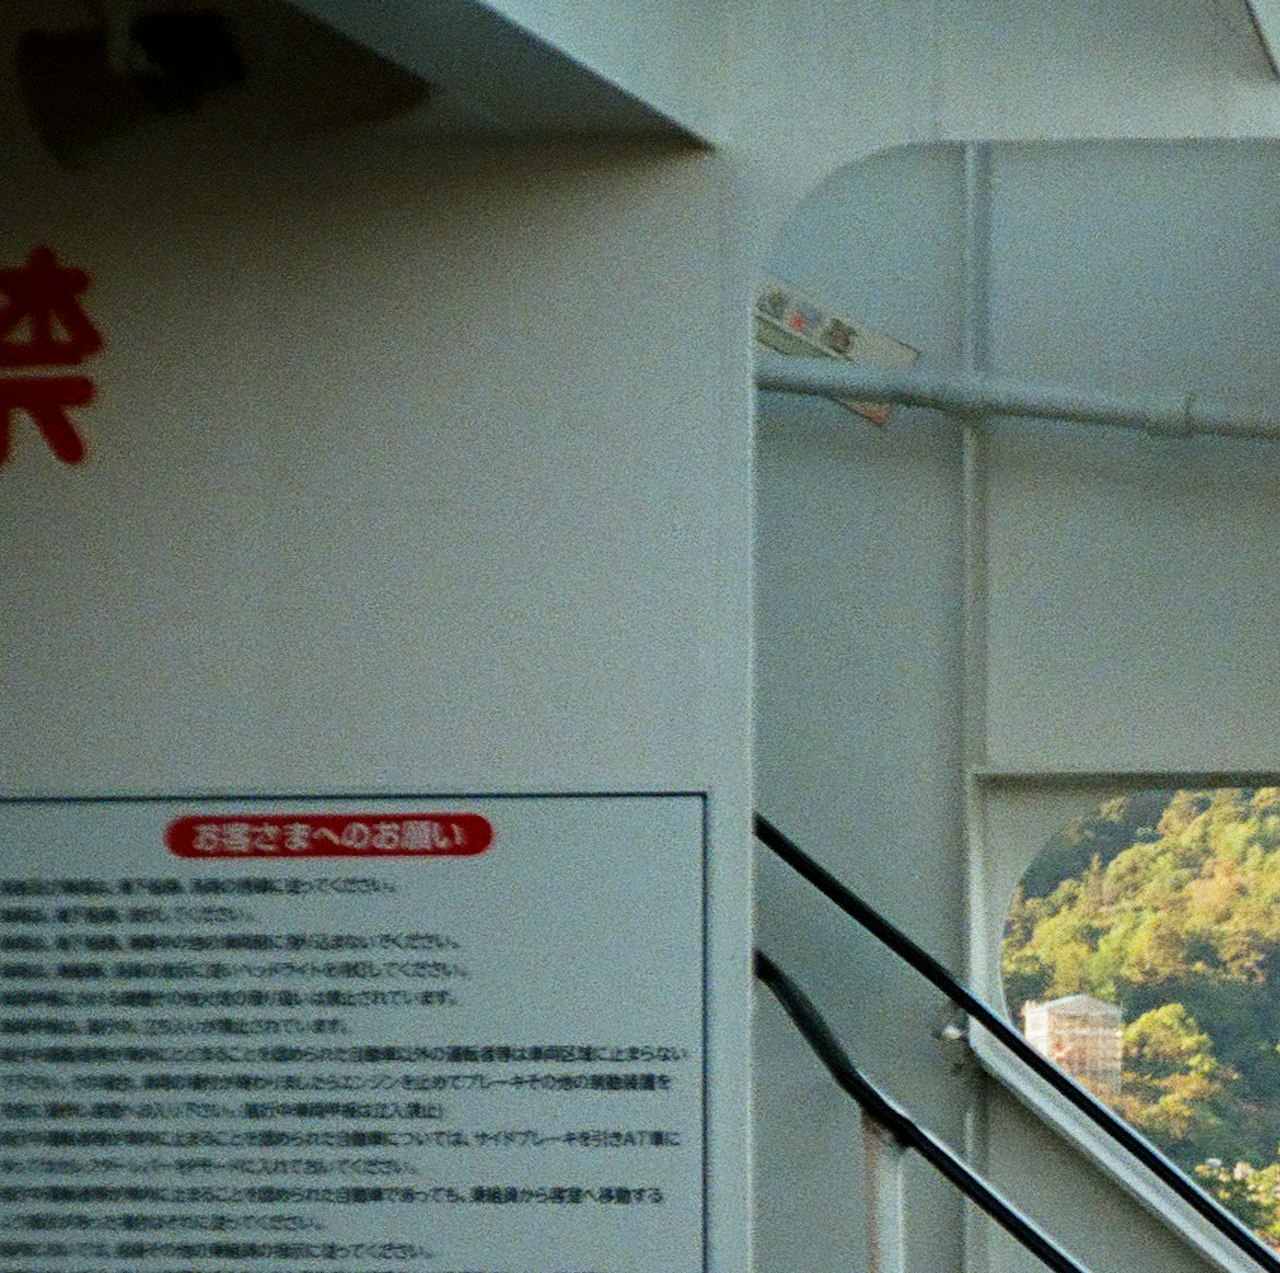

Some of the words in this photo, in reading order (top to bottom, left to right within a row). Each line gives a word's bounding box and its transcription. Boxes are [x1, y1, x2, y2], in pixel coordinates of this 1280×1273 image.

[191, 820, 467, 851] お客さまへのお願い
